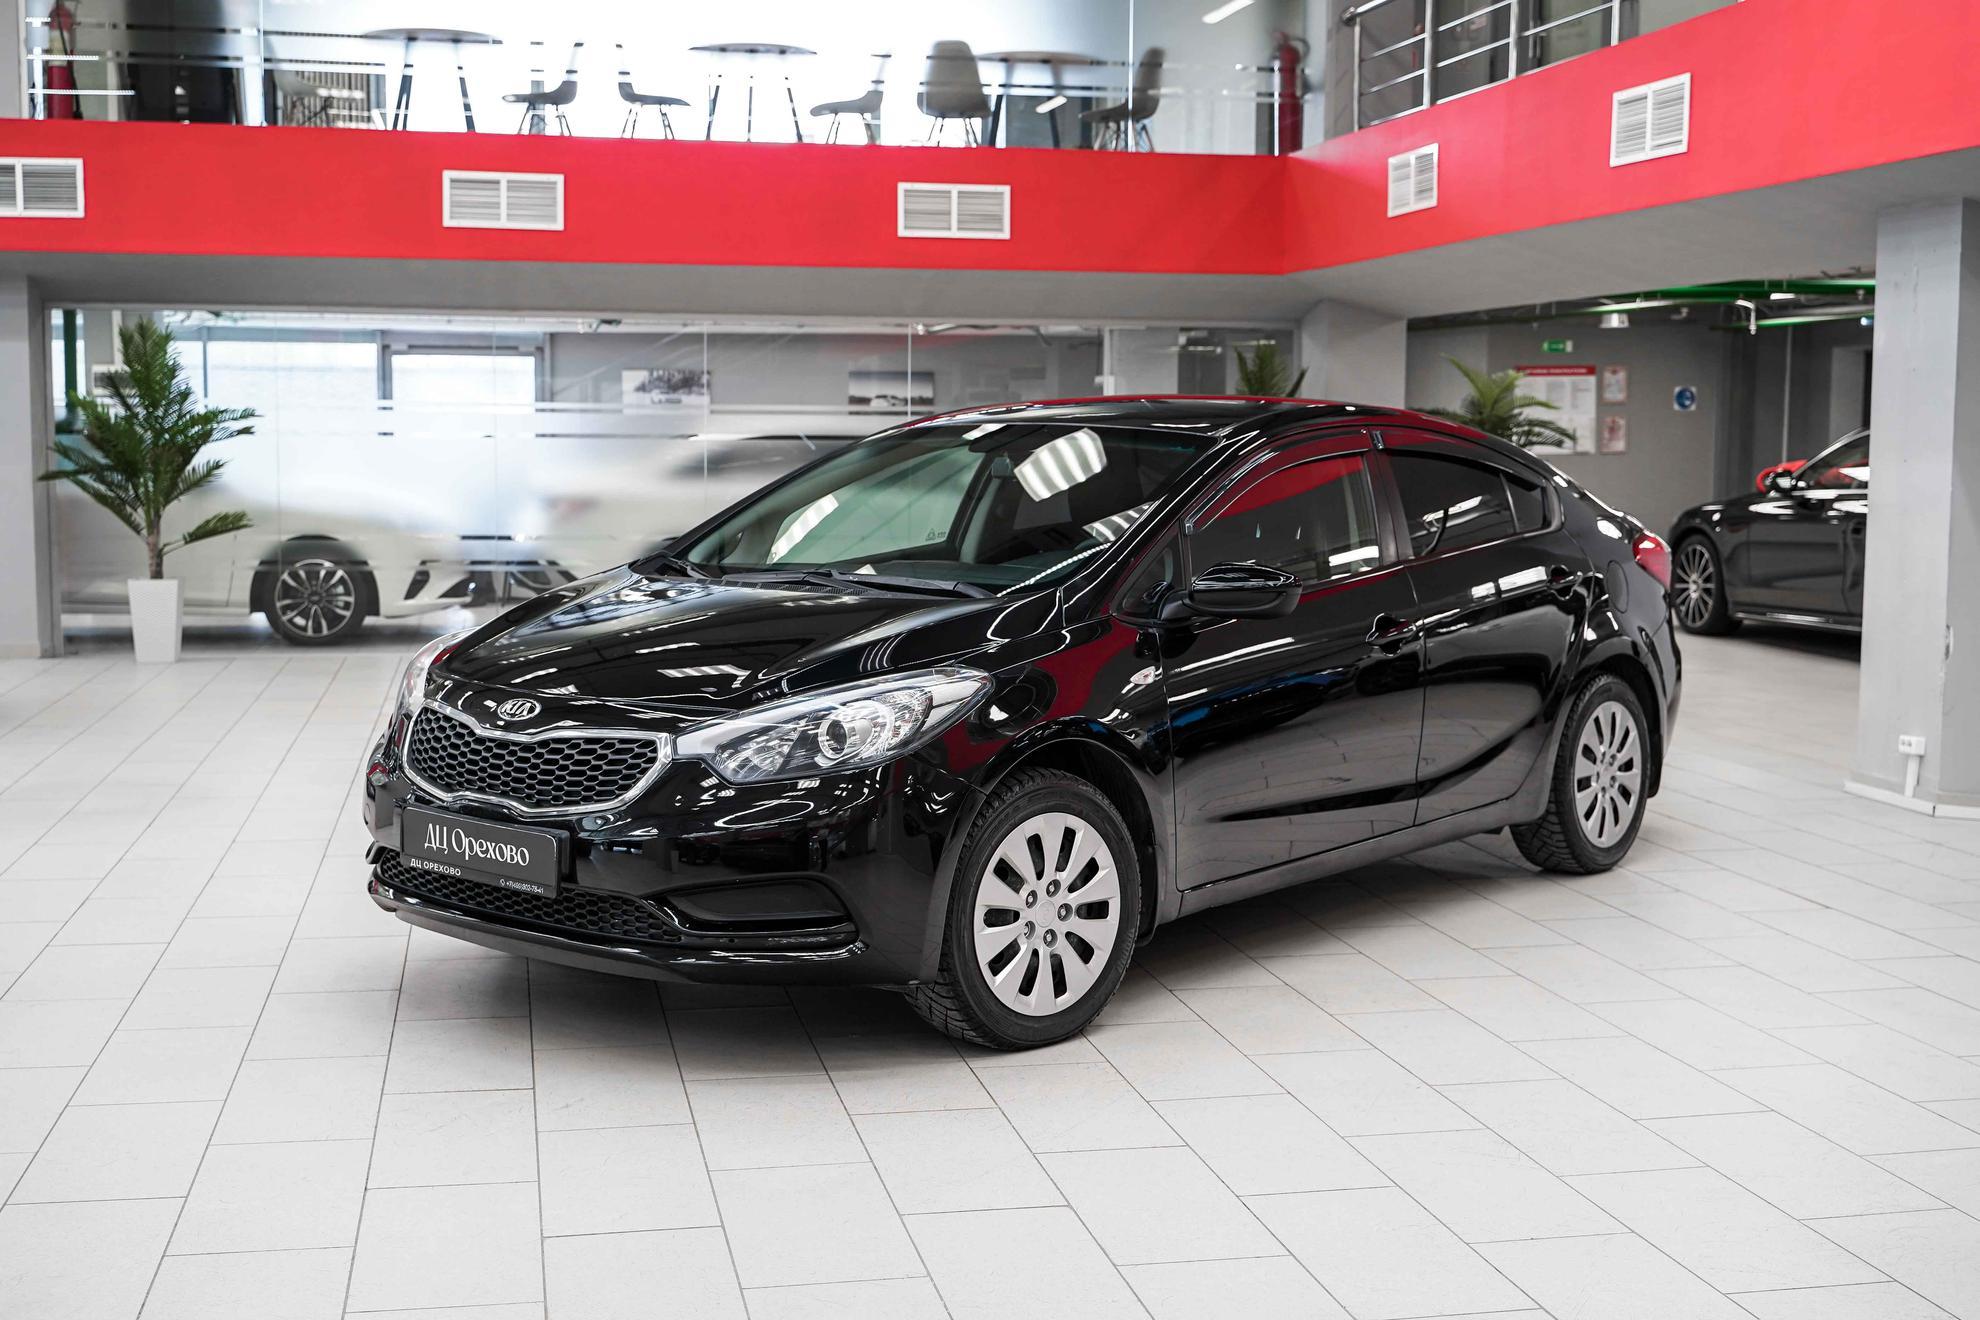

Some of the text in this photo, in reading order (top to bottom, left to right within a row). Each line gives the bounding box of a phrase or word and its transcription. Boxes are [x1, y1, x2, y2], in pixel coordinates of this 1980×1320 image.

[500, 700, 534, 717] KIA
[424, 823, 530, 866] ДЦ Орехово
[410, 858, 462, 876] ДЦ ОРЕХОВО
